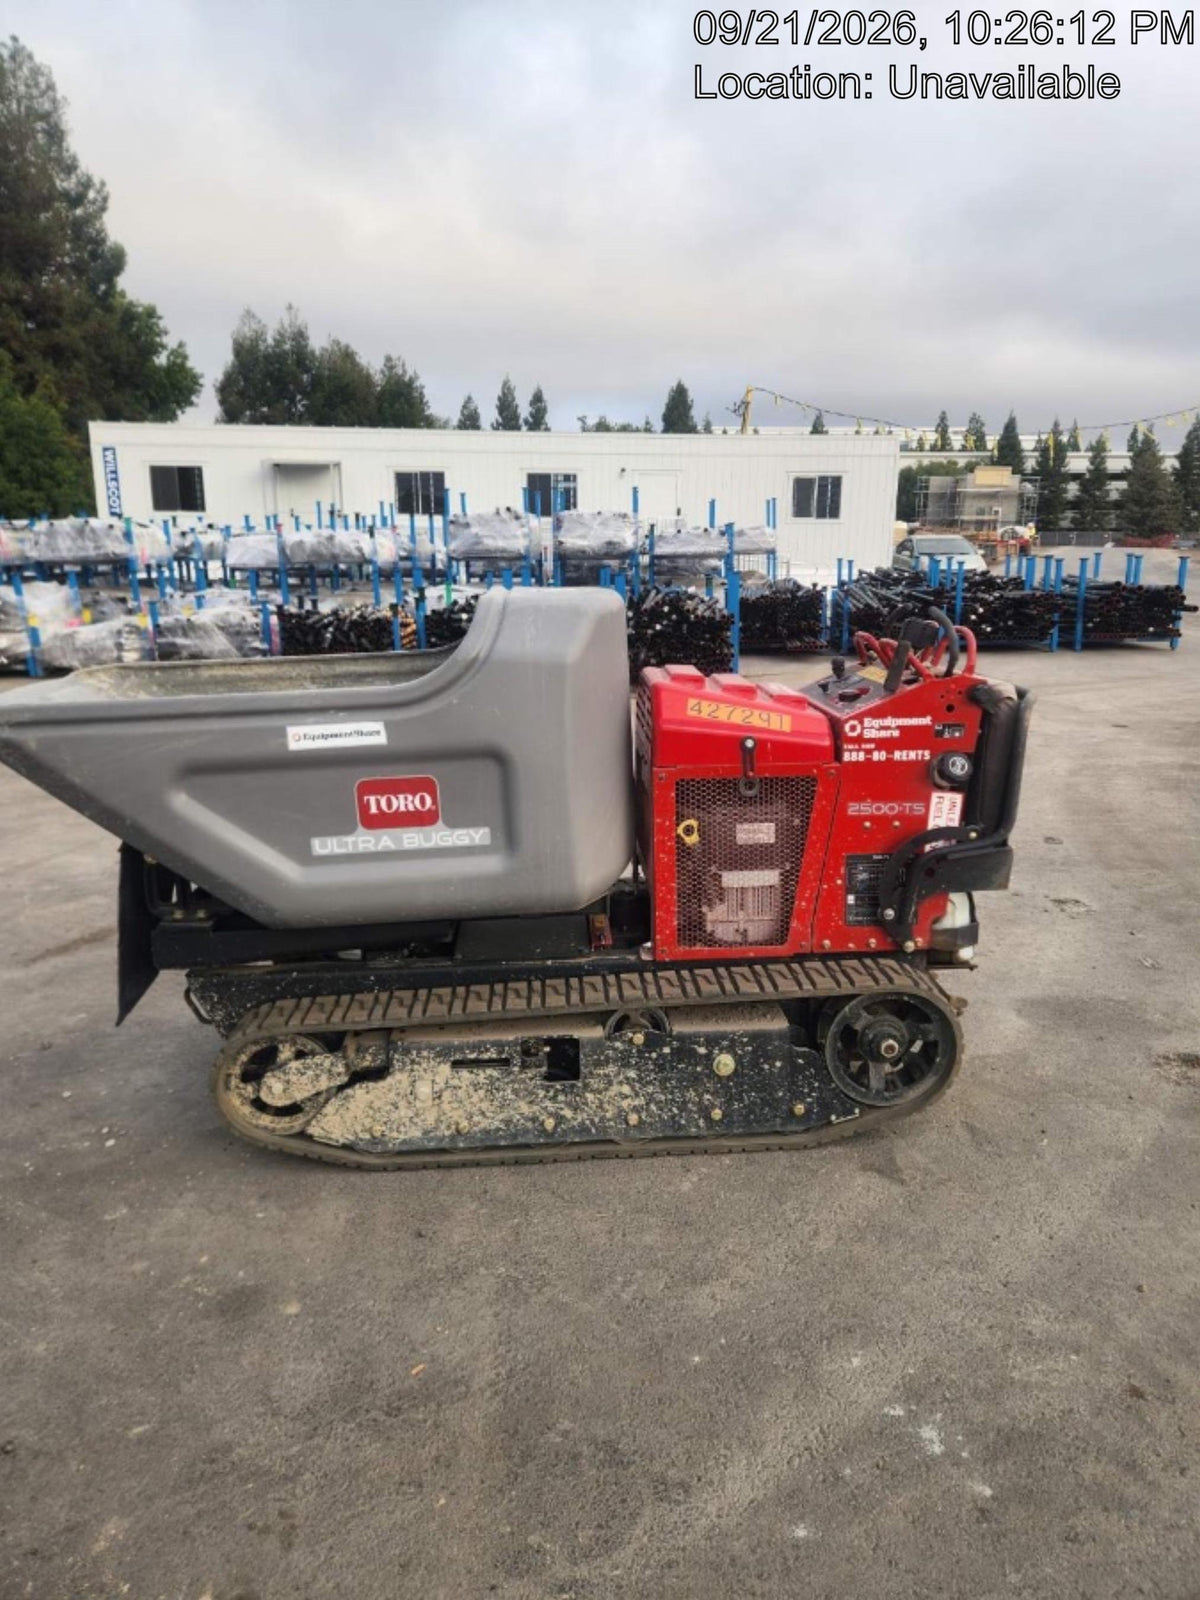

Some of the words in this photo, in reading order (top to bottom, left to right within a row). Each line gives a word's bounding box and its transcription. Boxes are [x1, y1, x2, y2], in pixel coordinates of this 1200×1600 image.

[104, 449, 121, 514] WILLSCOT
[864, 716, 932, 728] Equipment
[864, 729, 899, 739] Share
[843, 750, 931, 761] 888-80-RENTS
[363, 792, 433, 814] TORO
[314, 836, 395, 854] ULTRA
[403, 830, 484, 848] BUGGY
